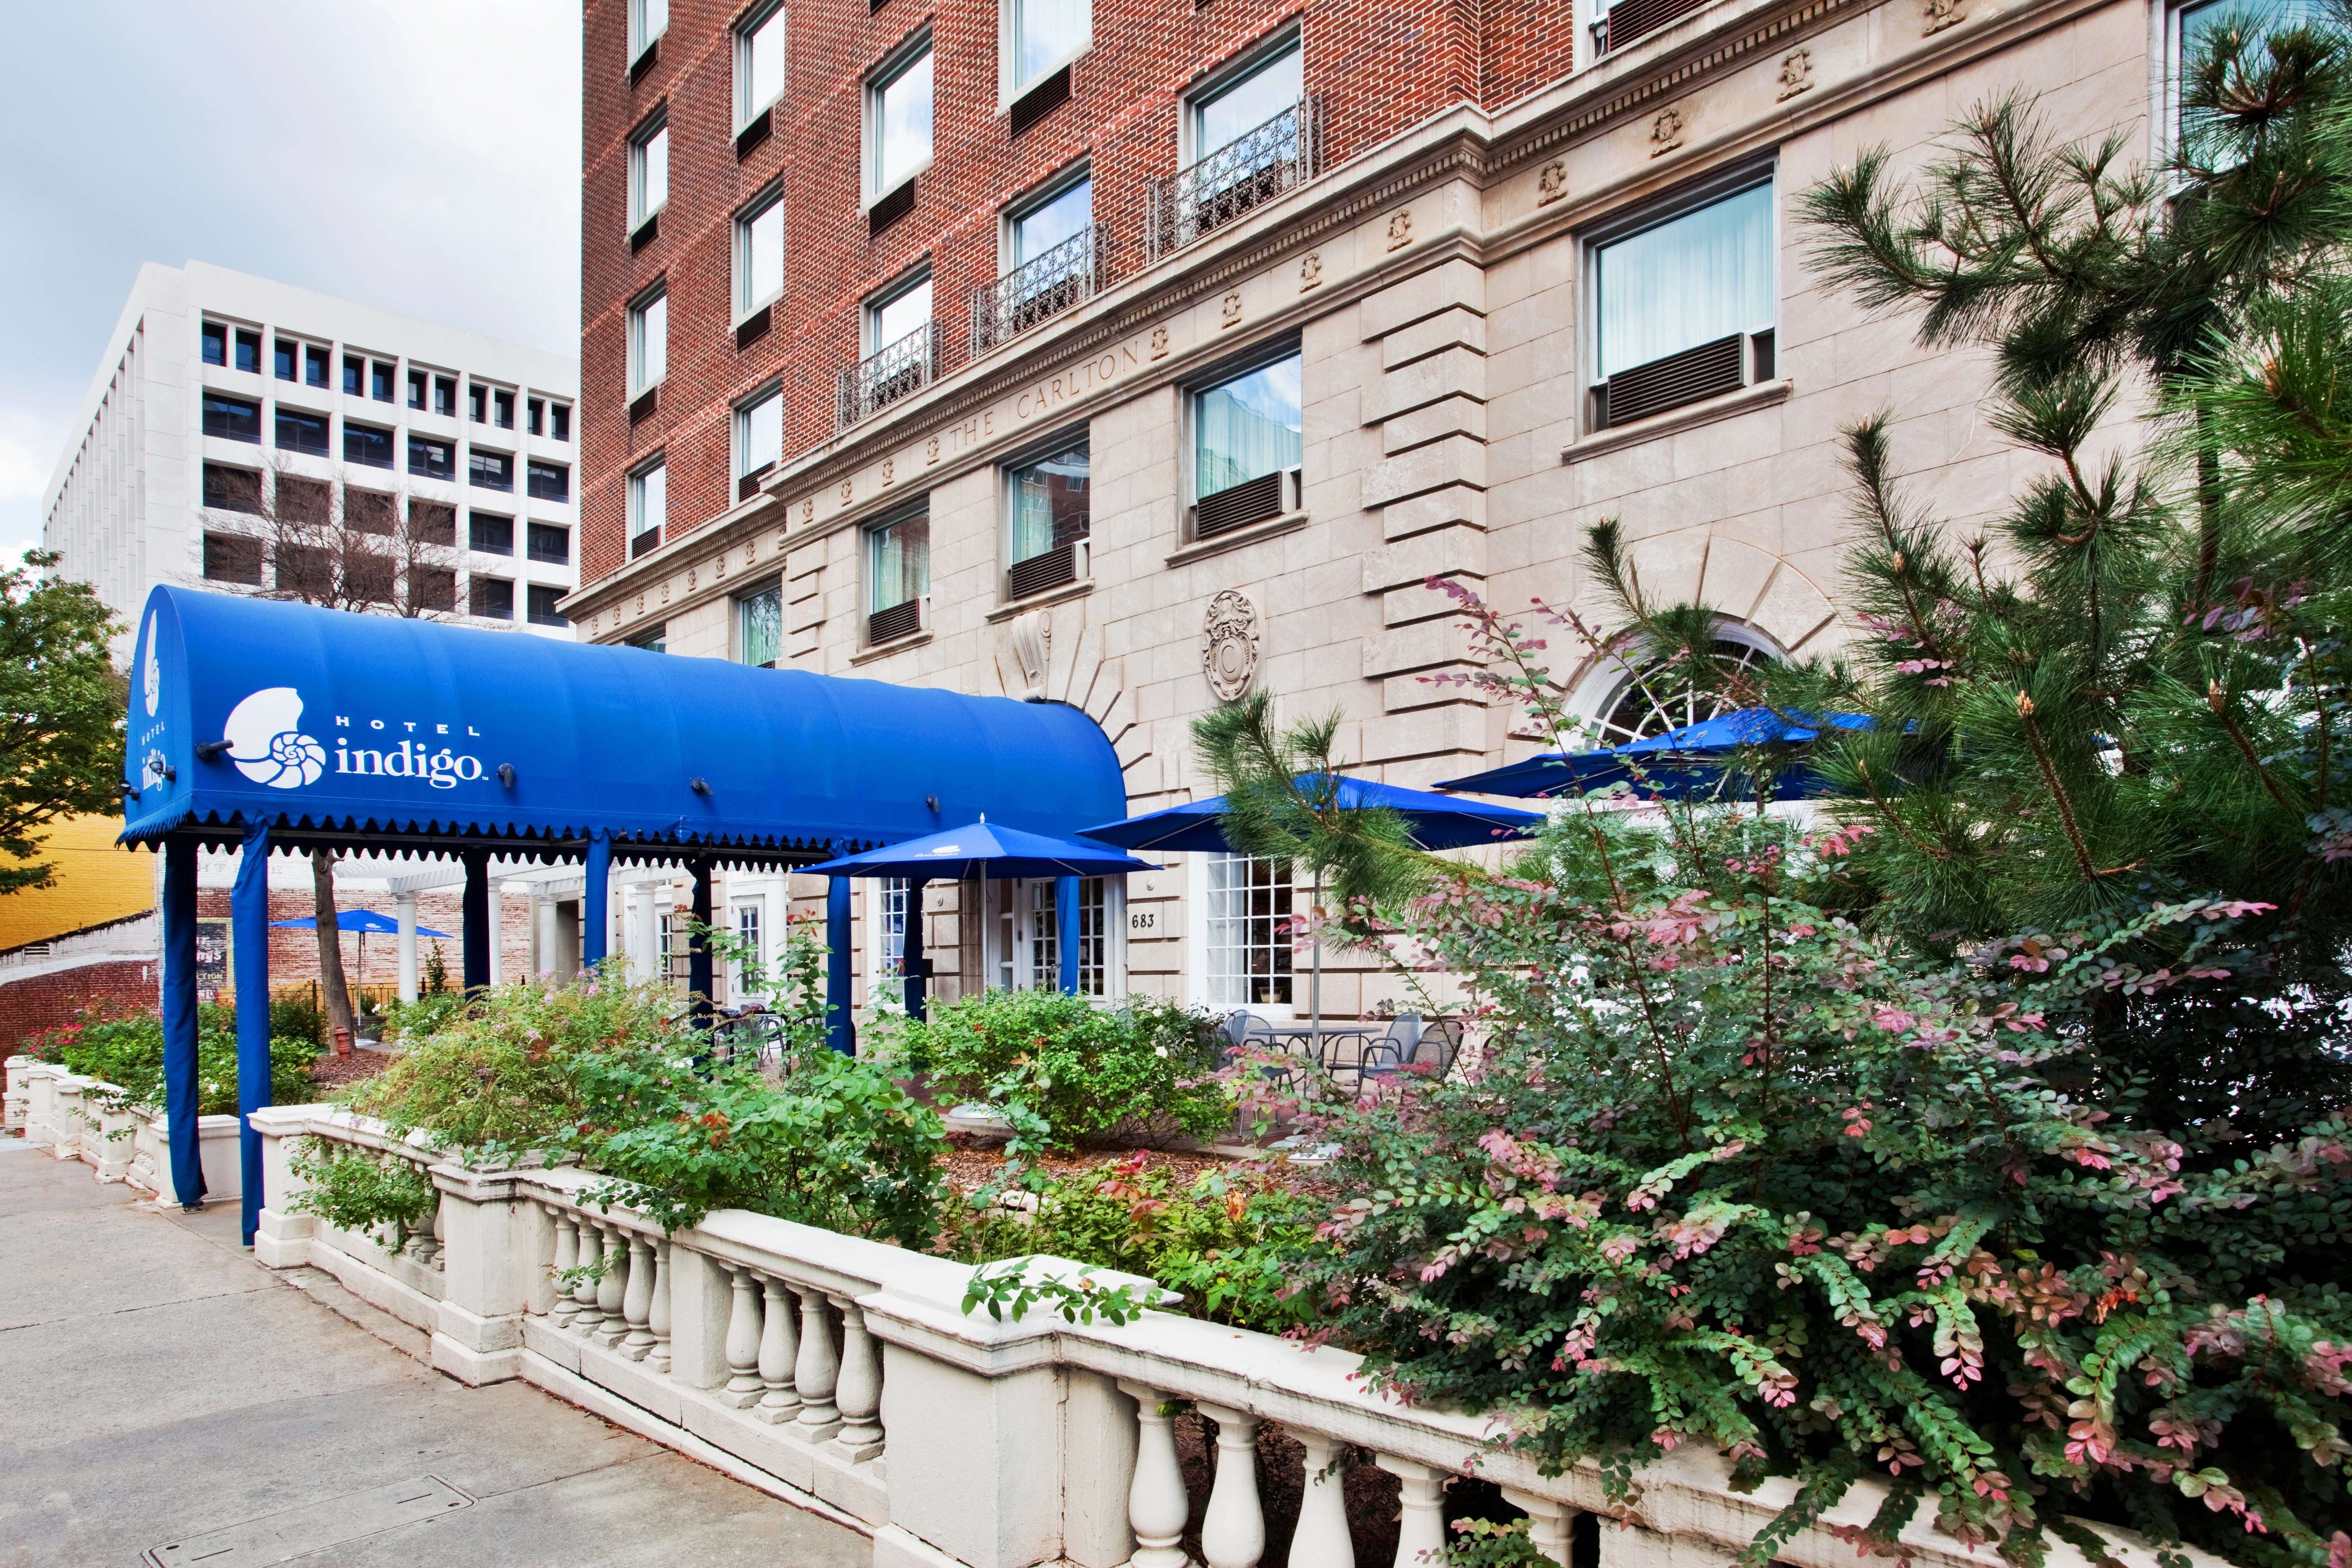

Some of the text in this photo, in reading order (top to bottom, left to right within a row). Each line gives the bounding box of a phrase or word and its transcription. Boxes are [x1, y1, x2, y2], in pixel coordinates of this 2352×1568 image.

[949, 341, 1138, 451] THE CARLTON
[142, 721, 165, 746] HOTEL
[335, 715, 480, 736] HOTEL
[334, 737, 482, 789] indigo
[1132, 914, 1154, 928] 683
